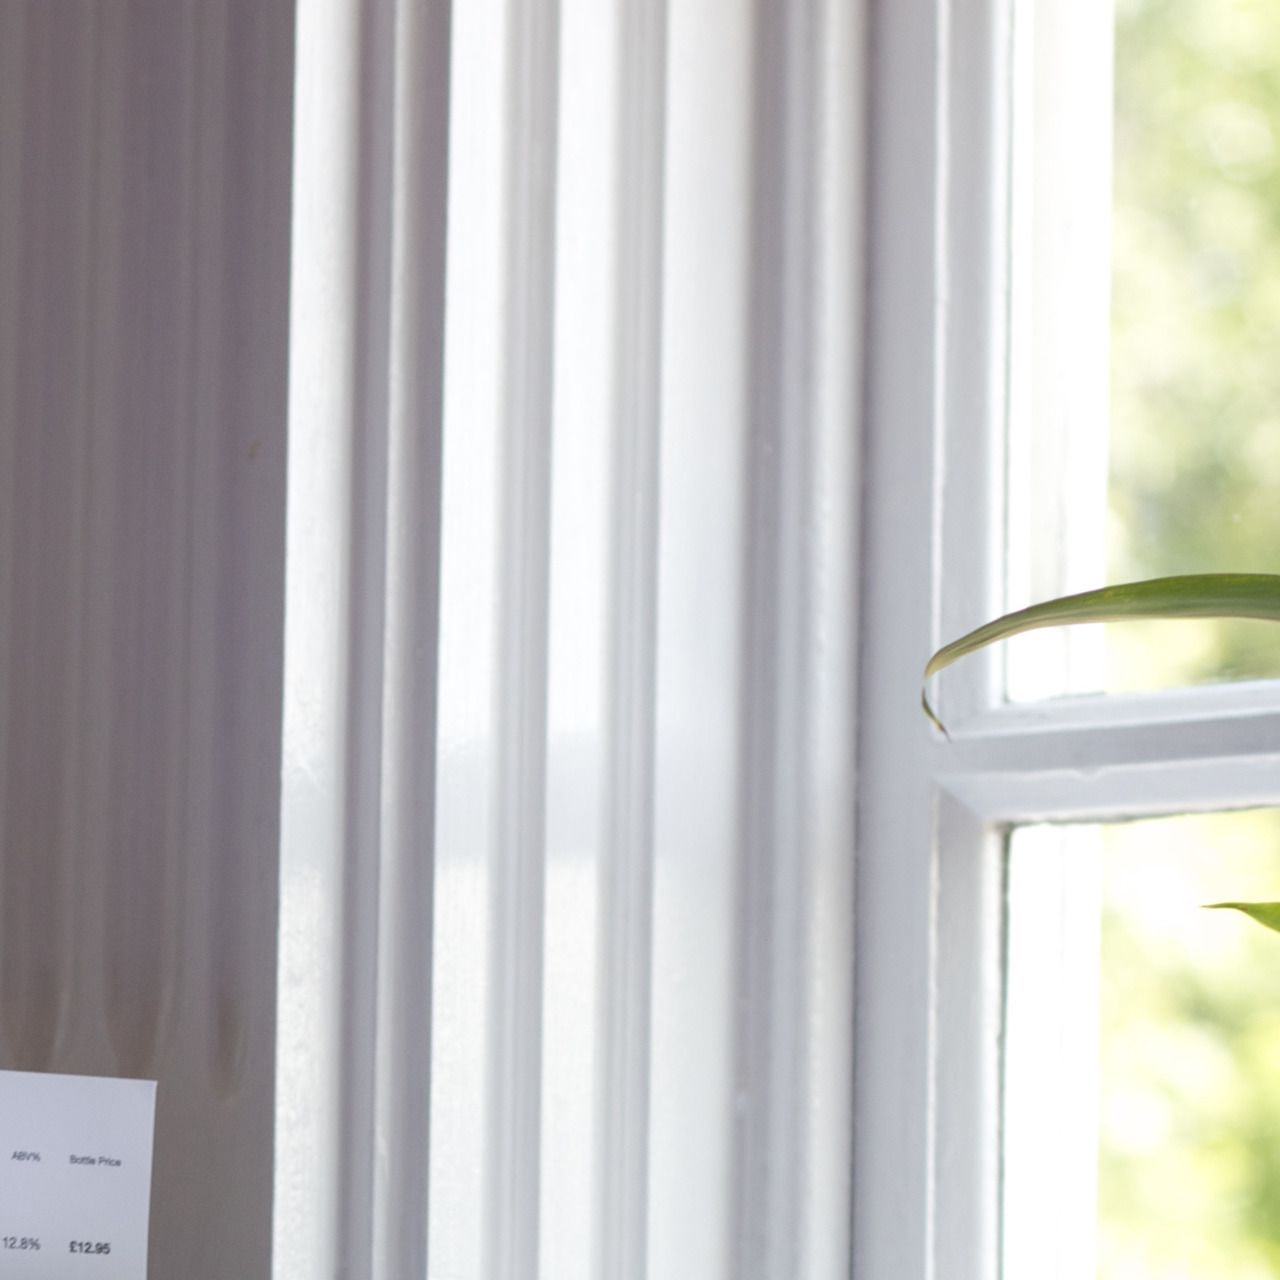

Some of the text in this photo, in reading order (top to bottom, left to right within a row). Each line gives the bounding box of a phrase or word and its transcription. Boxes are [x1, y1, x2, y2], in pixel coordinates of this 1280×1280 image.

[11, 1150, 41, 1162] ABV%
[69, 1154, 97, 1166] Bottle
[98, 1156, 122, 1167] Price
[2, 1236, 111, 1255] 12.8% £12.95
